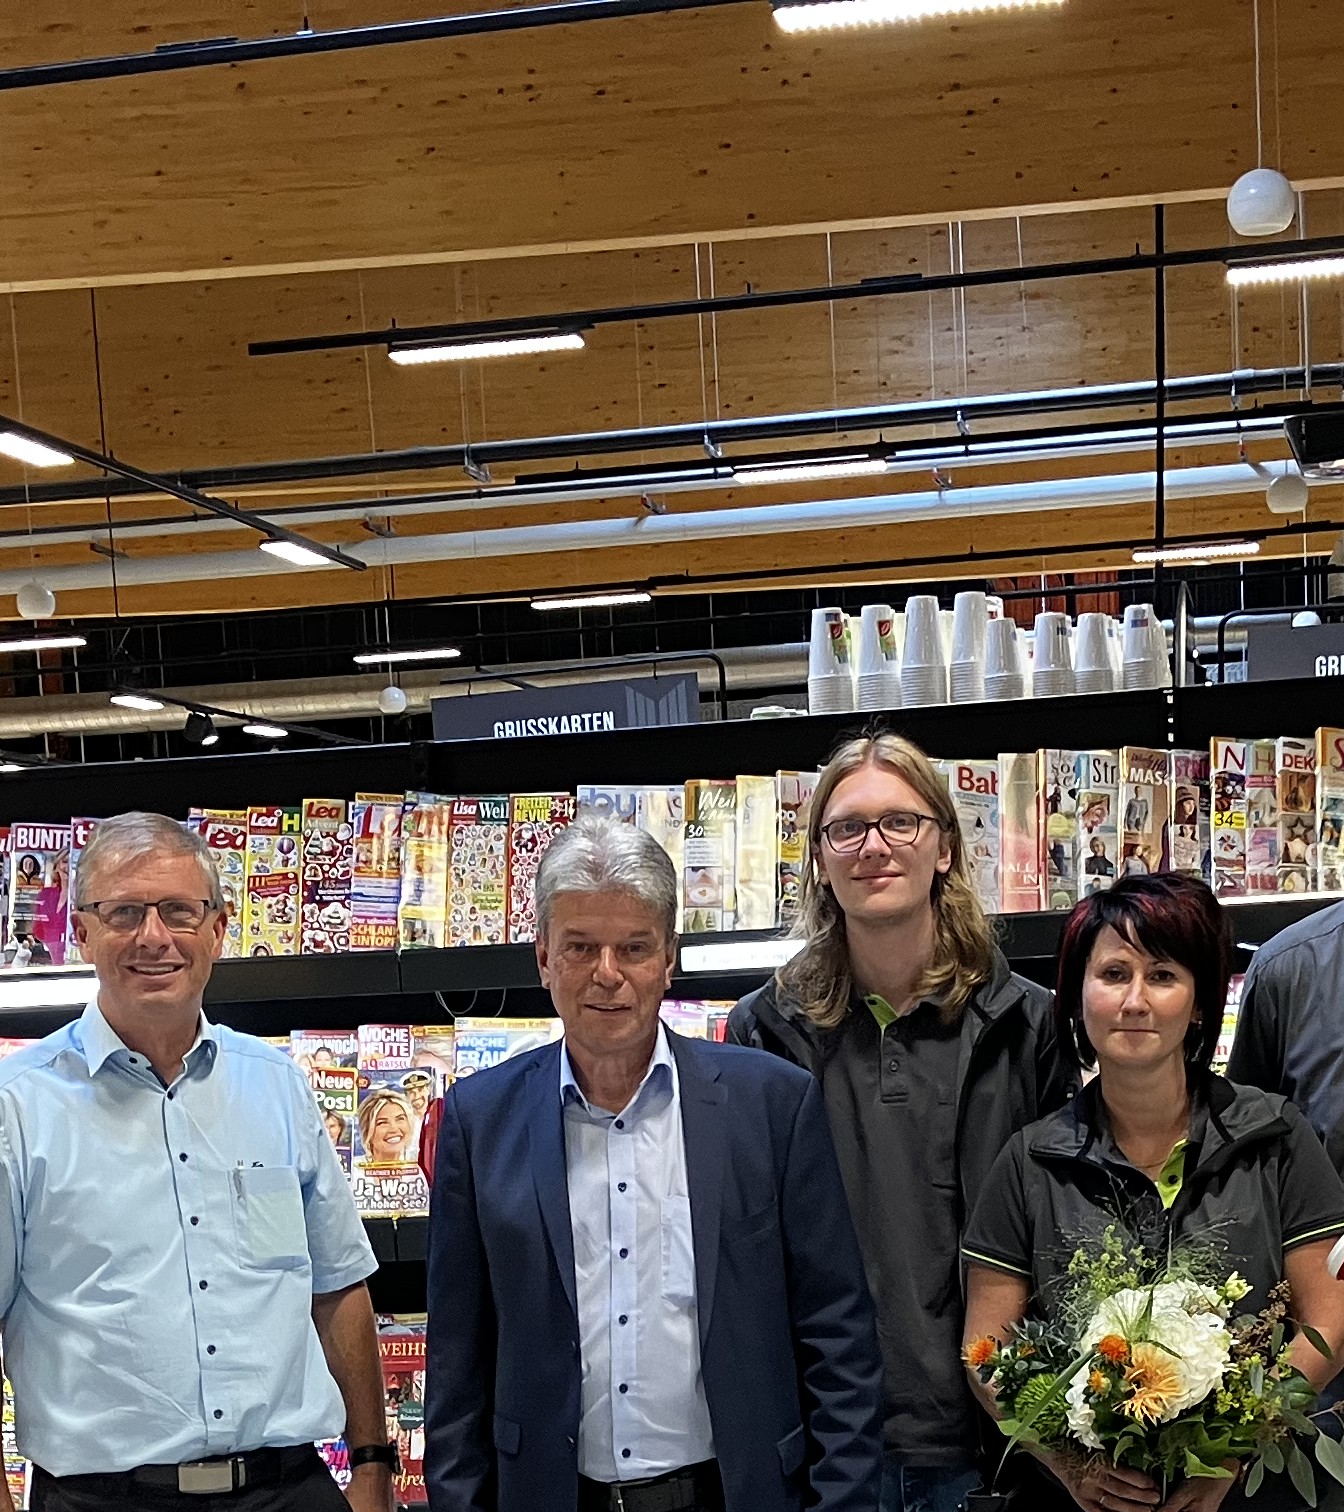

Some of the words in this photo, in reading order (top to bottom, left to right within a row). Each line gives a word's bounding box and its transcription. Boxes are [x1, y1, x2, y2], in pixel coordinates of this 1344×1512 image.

[307, 801, 341, 819] Lea
[453, 801, 477, 815] Lisa
[360, 1027, 409, 1042] WOCHE
[456, 1036, 505, 1048] WOCHE
[360, 1042, 409, 1057] HEUTE
[313, 1071, 354, 1089] Neue
[315, 1091, 353, 1110] Post
